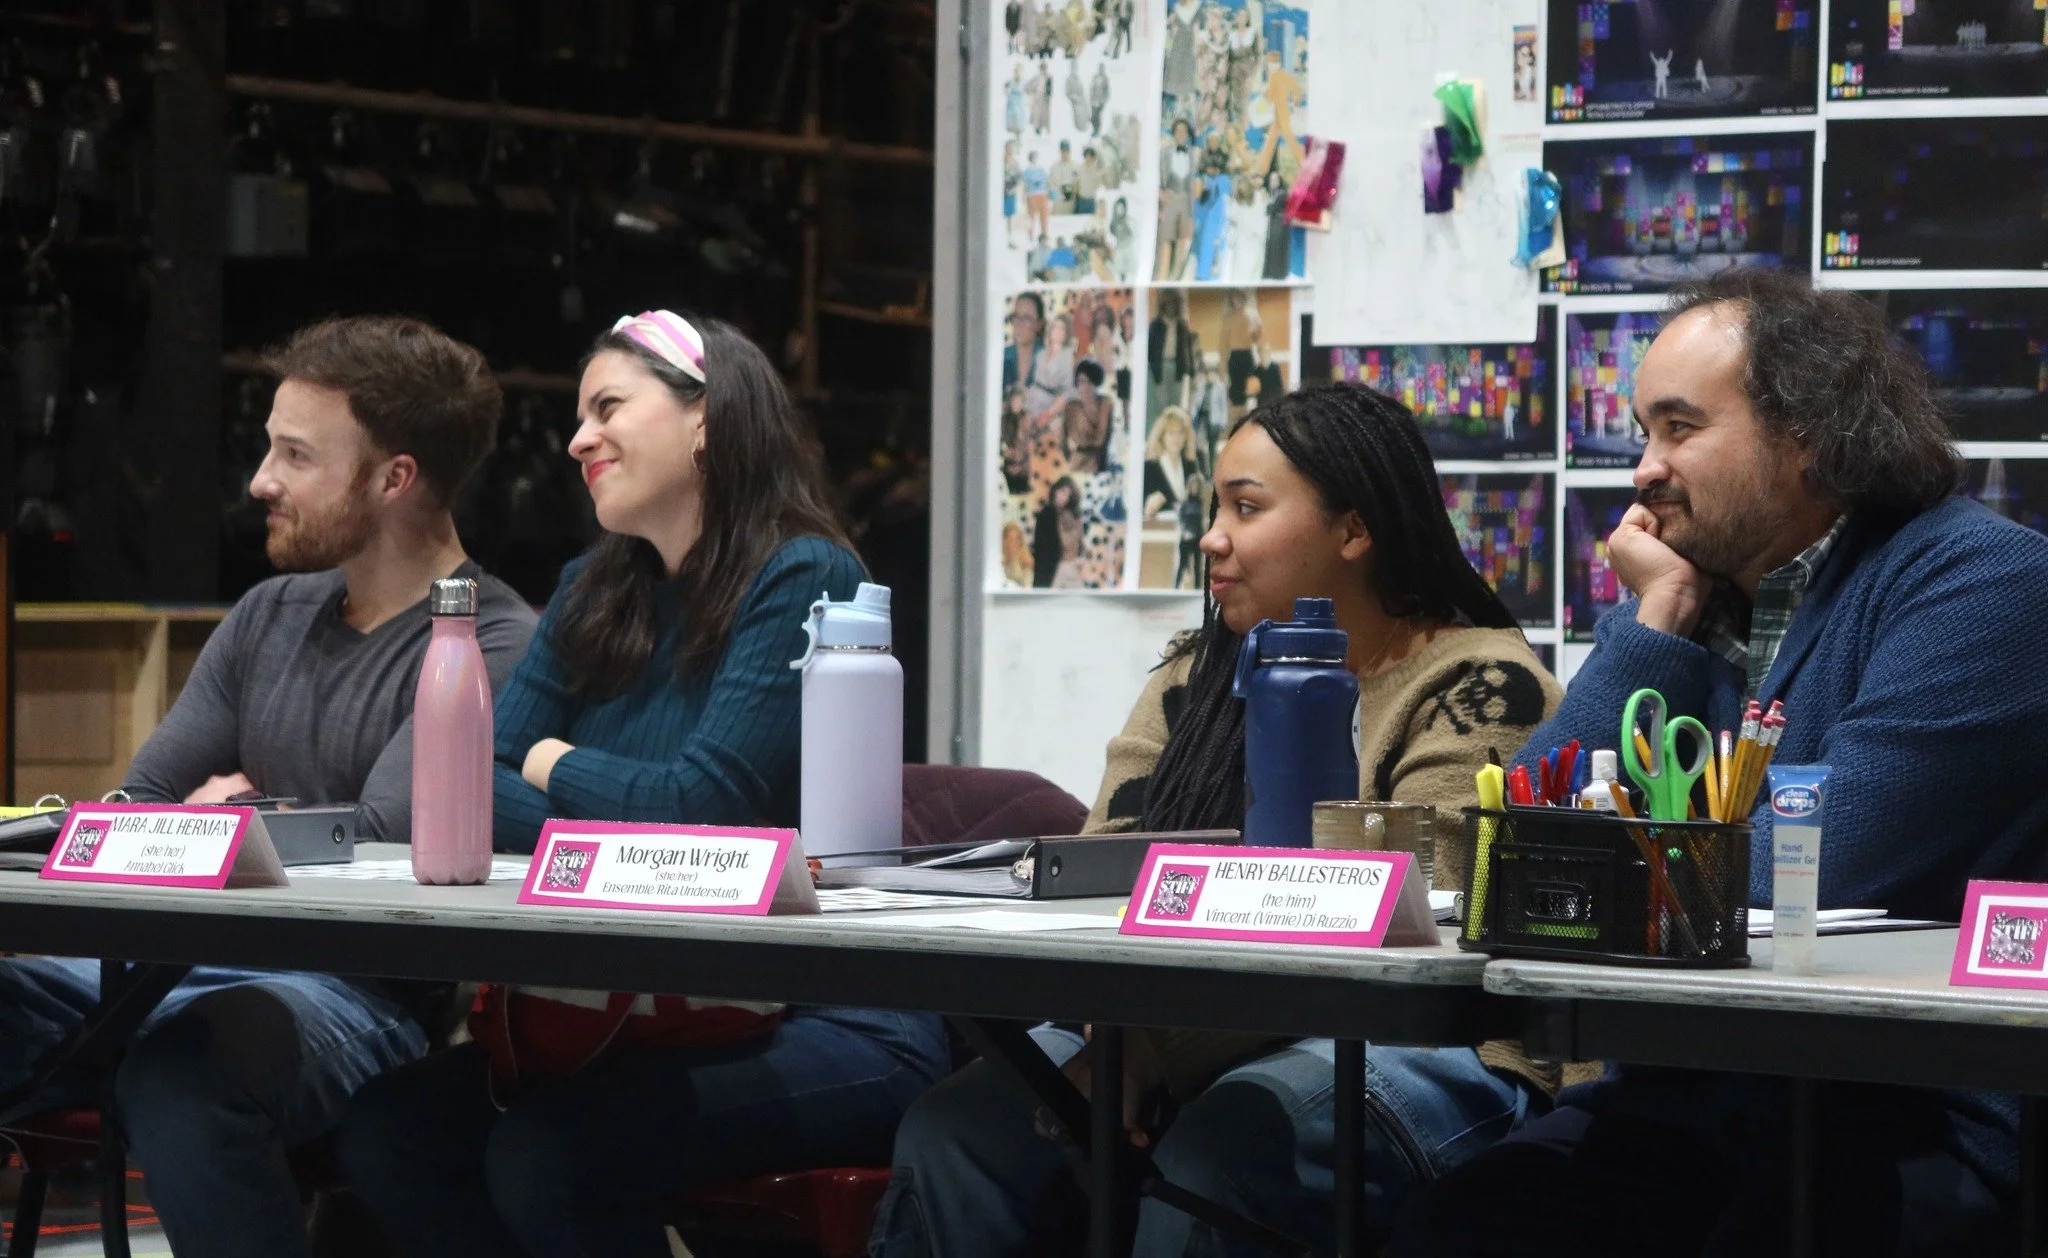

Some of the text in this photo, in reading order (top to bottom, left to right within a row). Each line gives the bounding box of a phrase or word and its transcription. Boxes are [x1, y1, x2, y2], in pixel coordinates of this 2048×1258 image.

[1785, 789, 1809, 798] clean
[1776, 795, 1816, 811] drops
[110, 816, 148, 833] MARA
[148, 818, 175, 835] JILL
[1781, 843, 1803, 853] Hand
[615, 845, 686, 870] Morgan
[690, 847, 751, 873] Wright
[123, 860, 185, 875] Annabel Glick
[1214, 861, 1268, 881] HENRY
[1268, 863, 1383, 886] BALLESTEROS
[679, 885, 742, 901] Understudy
[1205, 909, 1358, 930] Vincent (Vinnie) Di Ruzzio
